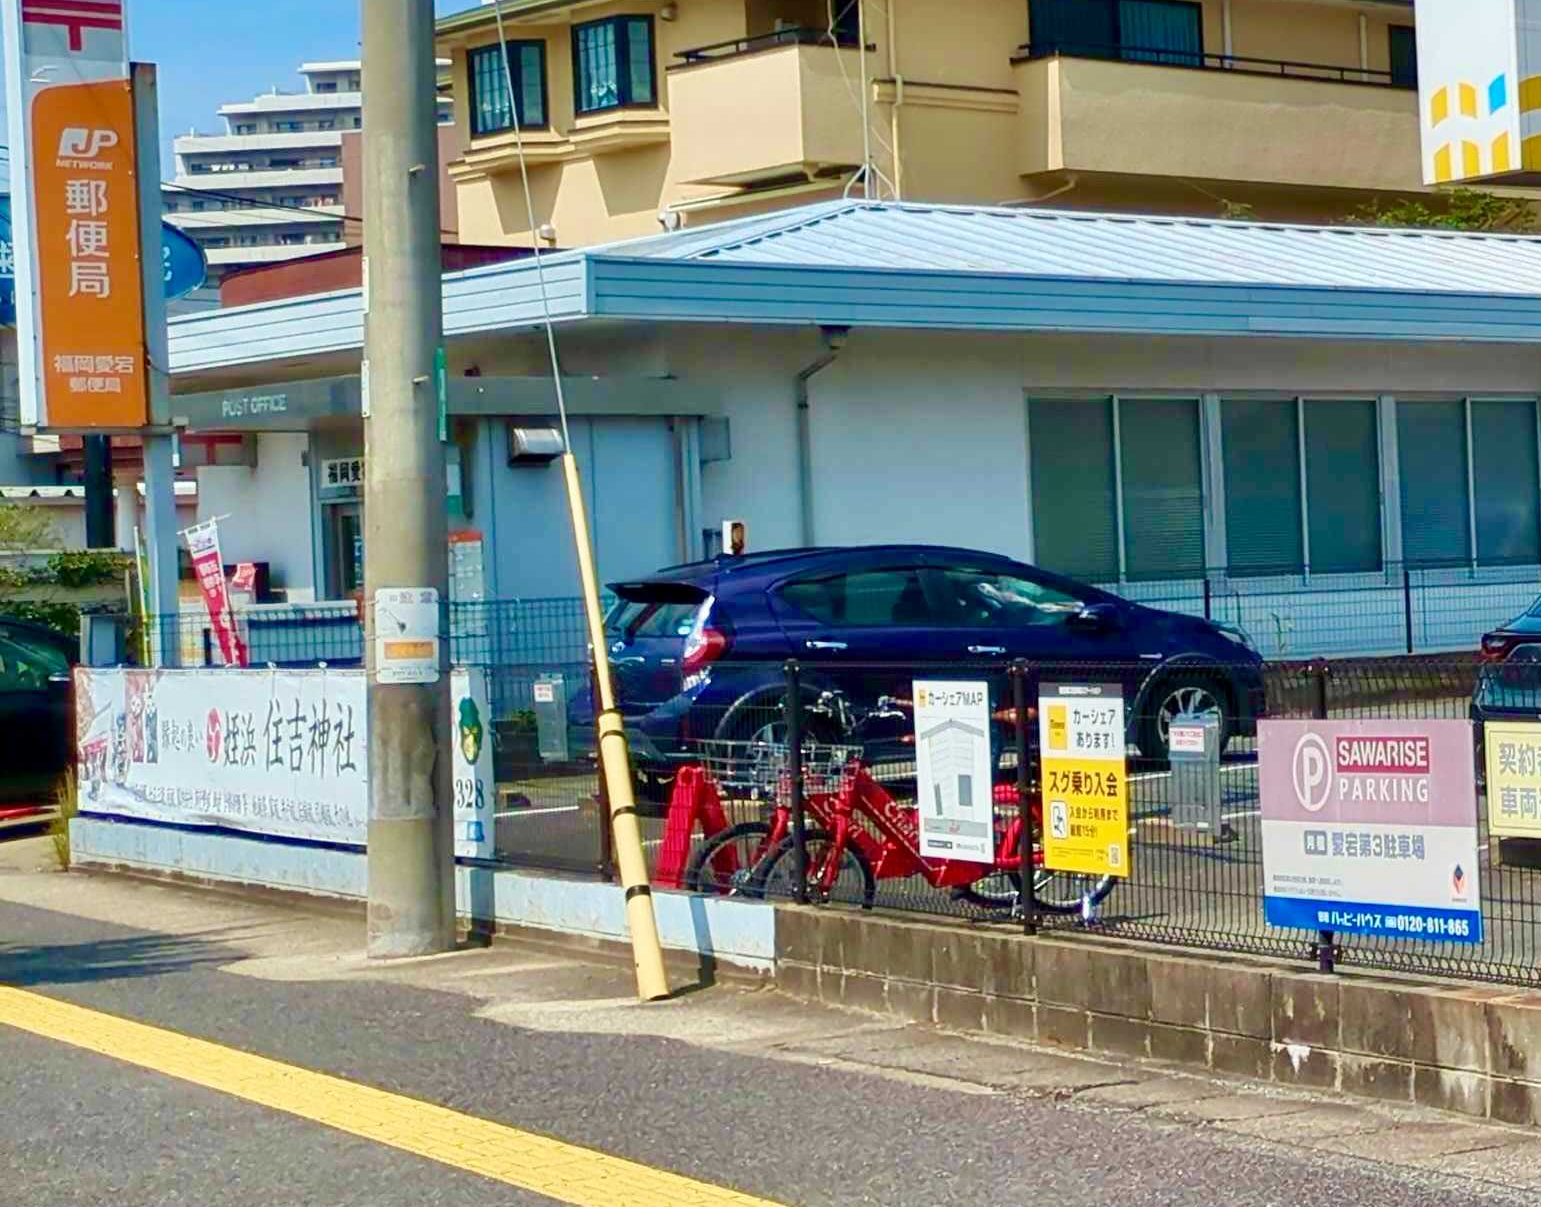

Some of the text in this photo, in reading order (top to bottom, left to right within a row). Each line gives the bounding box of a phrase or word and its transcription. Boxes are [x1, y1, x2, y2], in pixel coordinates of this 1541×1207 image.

[65, 178, 111, 300] 郵便局
[222, 393, 288, 417] POST OFFICE
[1073, 708, 1116, 726] カーシェア
[263, 696, 357, 780] 住吉神社
[1338, 739, 1429, 768] SAWARISE
[455, 777, 485, 809] 328
[1049, 769, 1118, 797] スグ乗り入会
[1339, 776, 1429, 803] PARKING
